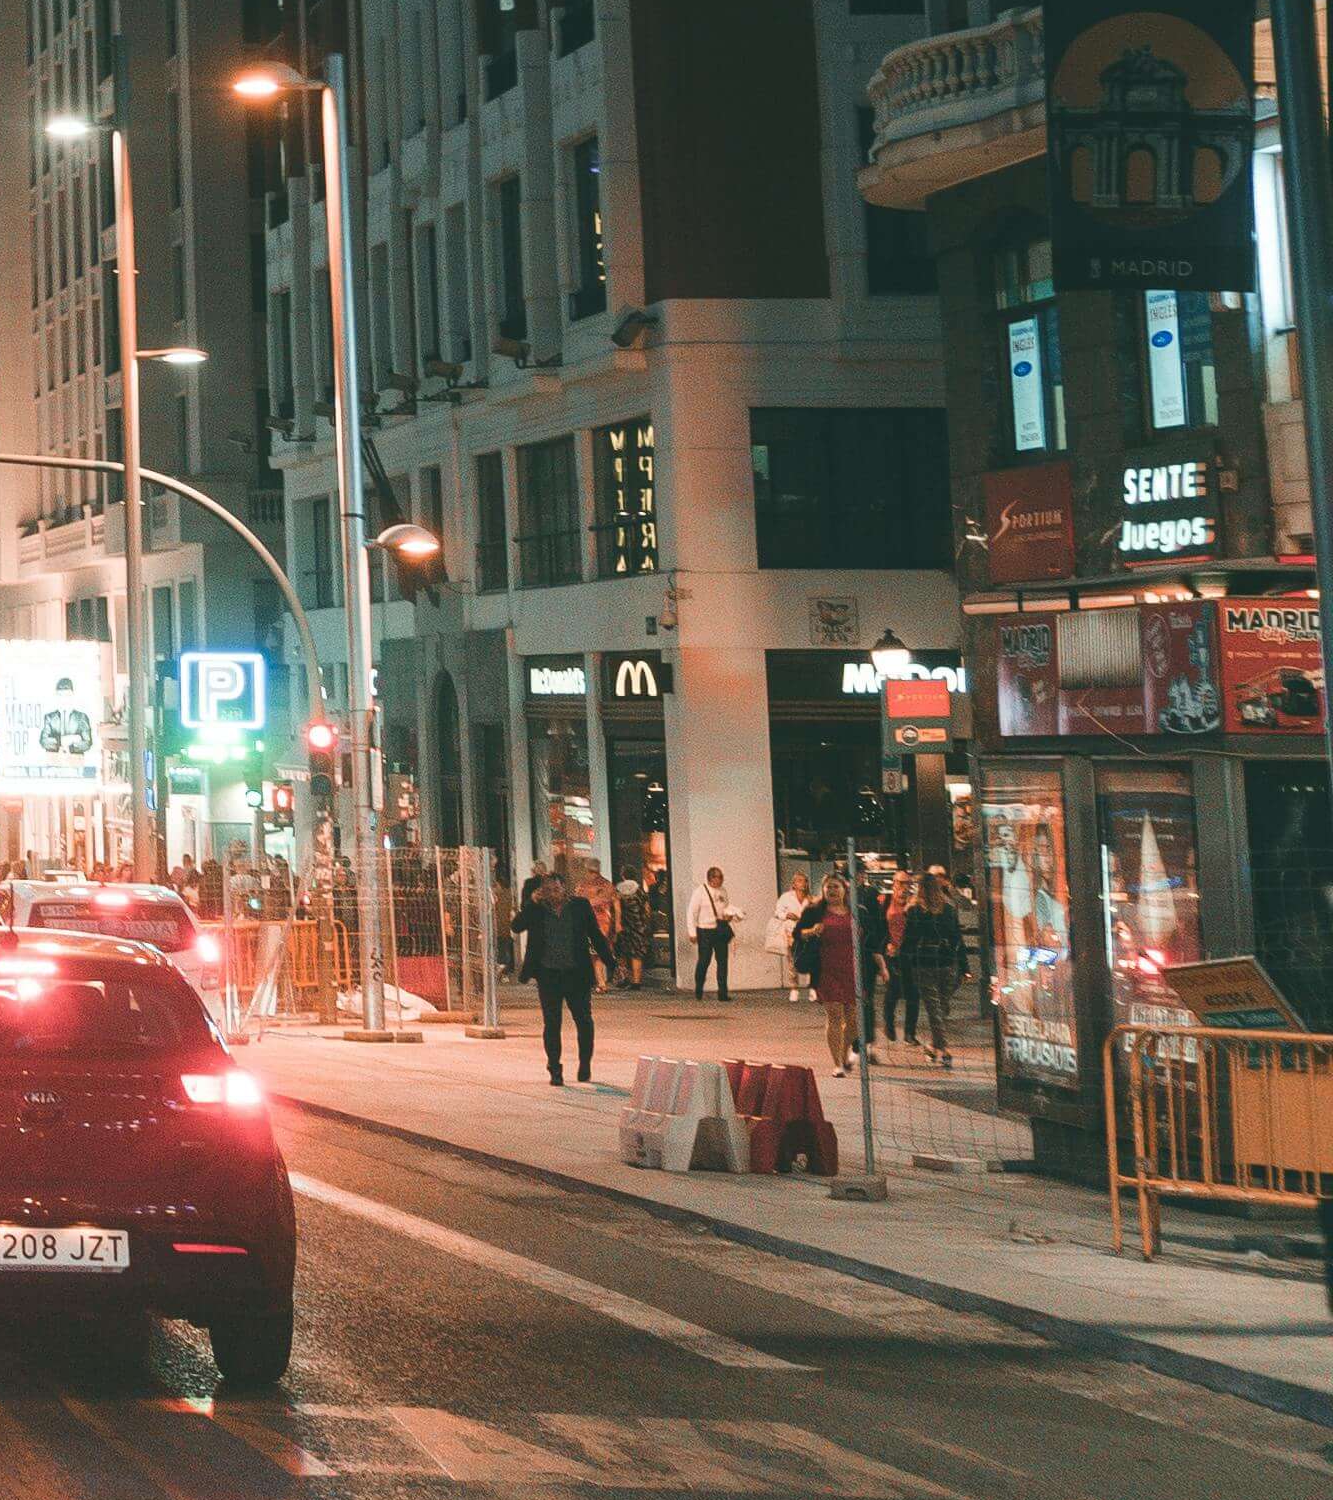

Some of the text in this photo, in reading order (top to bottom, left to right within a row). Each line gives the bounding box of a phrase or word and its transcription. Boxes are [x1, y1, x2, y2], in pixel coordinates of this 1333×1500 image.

[1111, 259, 1193, 278] MADRID
[1123, 461, 1201, 505] SENTE
[1118, 516, 1209, 554] Juegos
[198, 660, 245, 722] P
[30, 1092, 56, 1104] KIA
[70, 1232, 123, 1262] JZT
